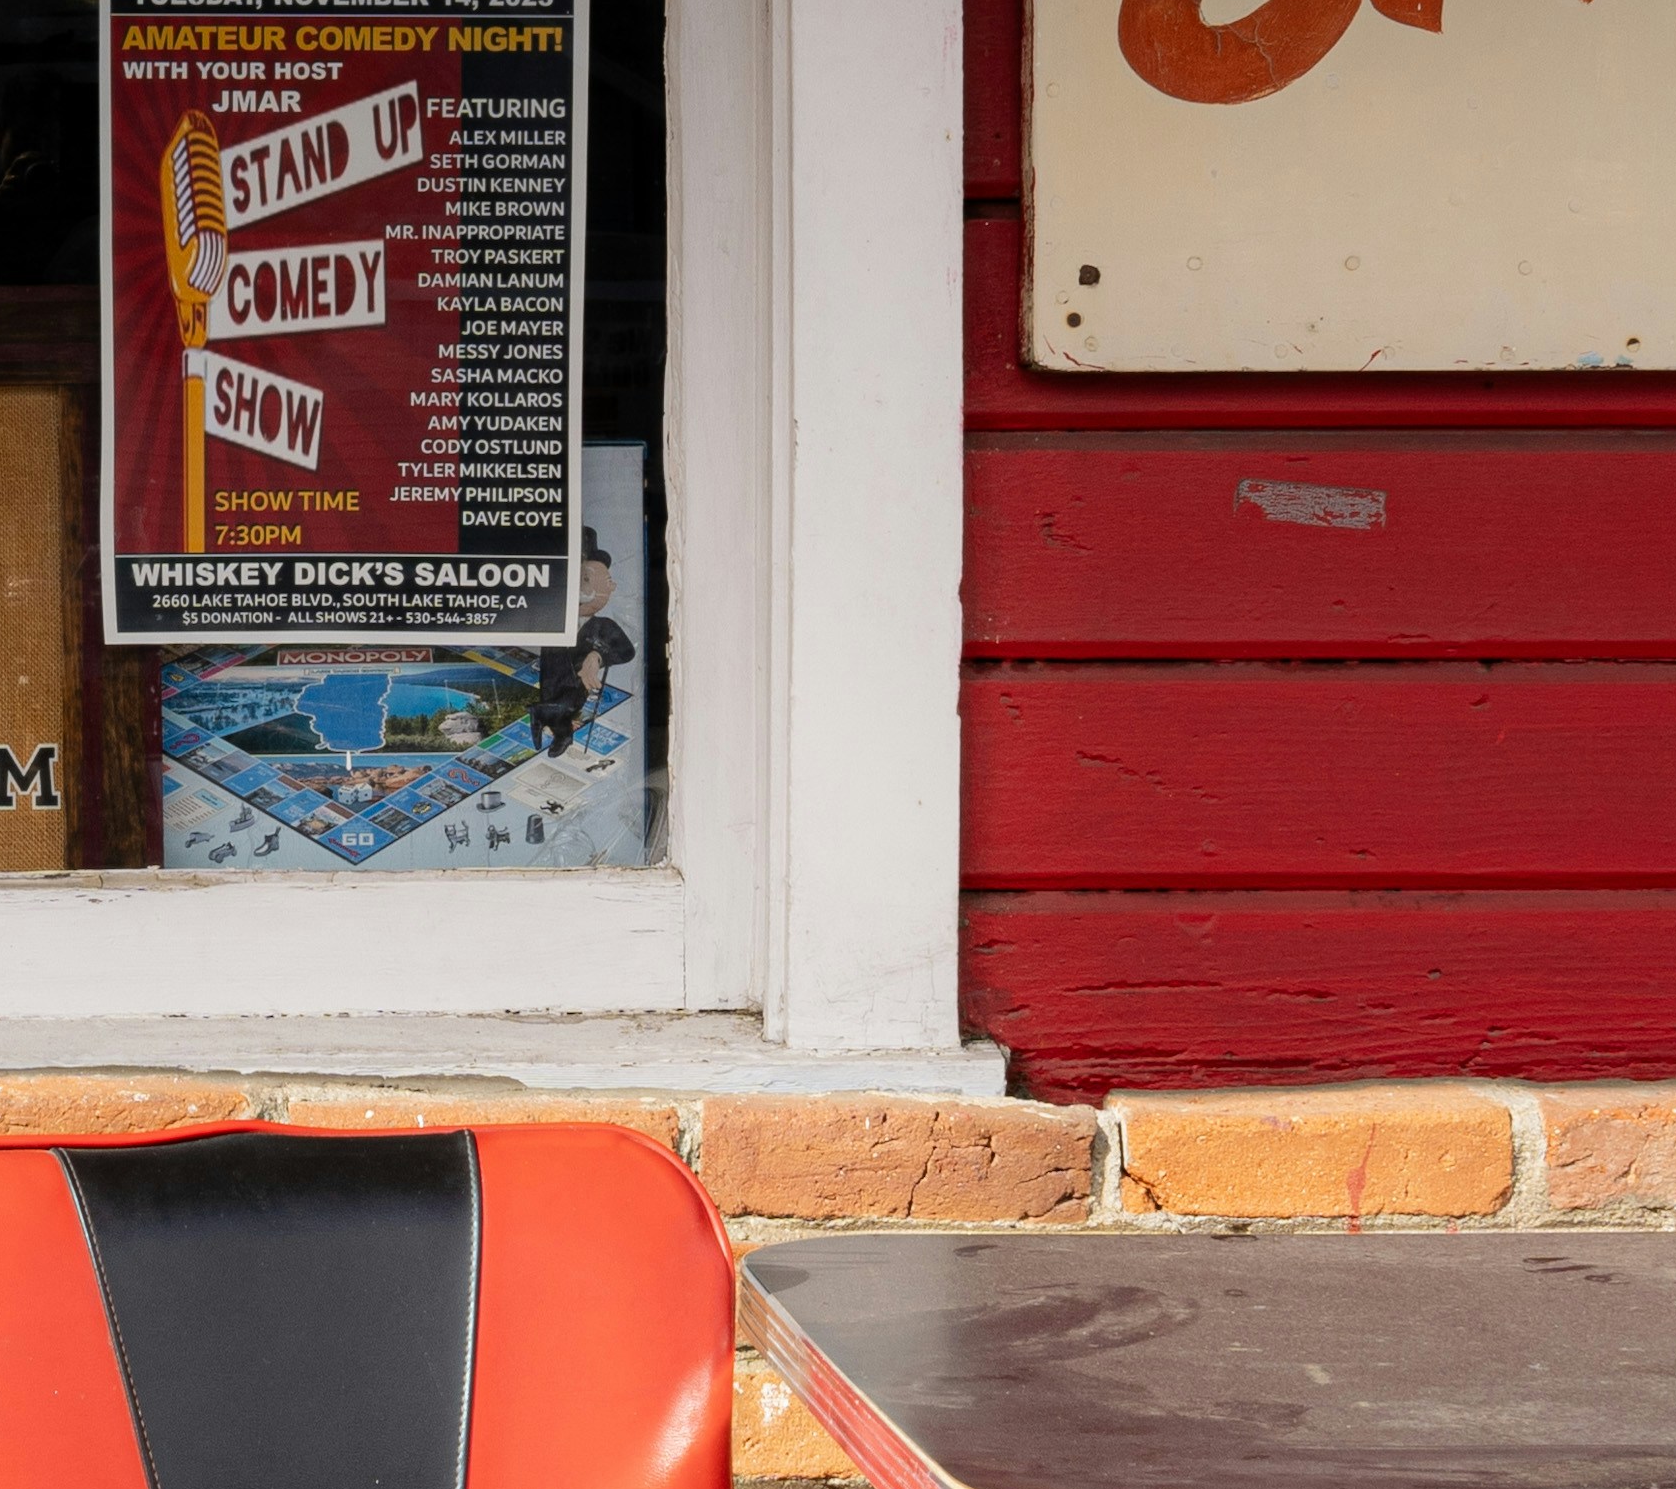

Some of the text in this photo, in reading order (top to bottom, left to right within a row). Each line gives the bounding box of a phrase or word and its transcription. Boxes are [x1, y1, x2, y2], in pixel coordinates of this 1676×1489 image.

[122, 26, 563, 52] AMATEUR COMEDY NIGHT!
[123, 62, 343, 80] WITH YOUR HOST
[212, 90, 302, 113] JMAR
[426, 98, 566, 118] FEATURING
[449, 130, 566, 146] ALEX MILLER
[231, 93, 418, 214] STAND UP
[430, 154, 566, 169] SETH GORMAN
[417, 178, 566, 193] DUSTIN KENNEY
[445, 201, 565, 216] MIKE BROWN
[385, 225, 565, 240] MR. INAPPROPRIATE
[431, 249, 565, 265] TROY PASKERT
[227, 249, 382, 326] COMEDY
[418, 273, 564, 289] DAMIAN LANUM
[437, 297, 564, 312] KAYLA BACON
[461, 320, 564, 336] JOE MAYER
[438, 344, 564, 359] MESSY JONES
[431, 368, 563, 384] SASHA MACKO
[410, 392, 563, 408] MARY KOLLAROS
[213, 367, 321, 454] SHOW
[427, 415, 562, 431] AMY YUDAKEN
[420, 439, 563, 455] CODY OSTLUND
[398, 462, 562, 478] TYLER MIKKELSEN
[214, 491, 360, 512] SHOW TIME
[389, 487, 562, 503] JEREMY PHILIPSON
[462, 511, 563, 527] DAVE COYE
[215, 525, 302, 545] 7:30PM
[132, 563, 550, 588] WHISKEY DICK'S SALOON
[152, 594, 528, 611] 2660 LAKE TAHOE BLVD., SOUTH LAKE TAHOE, CA
[182, 611, 199, 625] $5
[201, 611, 274, 624] DONATION
[288, 612, 314, 624] ALL
[316, 612, 368, 624] SHOWS
[369, 612, 394, 625] 21+
[405, 612, 497, 626] 530-544-3857
[281, 648, 430, 665] MONOPOLY
[342, 833, 375, 846] GO
